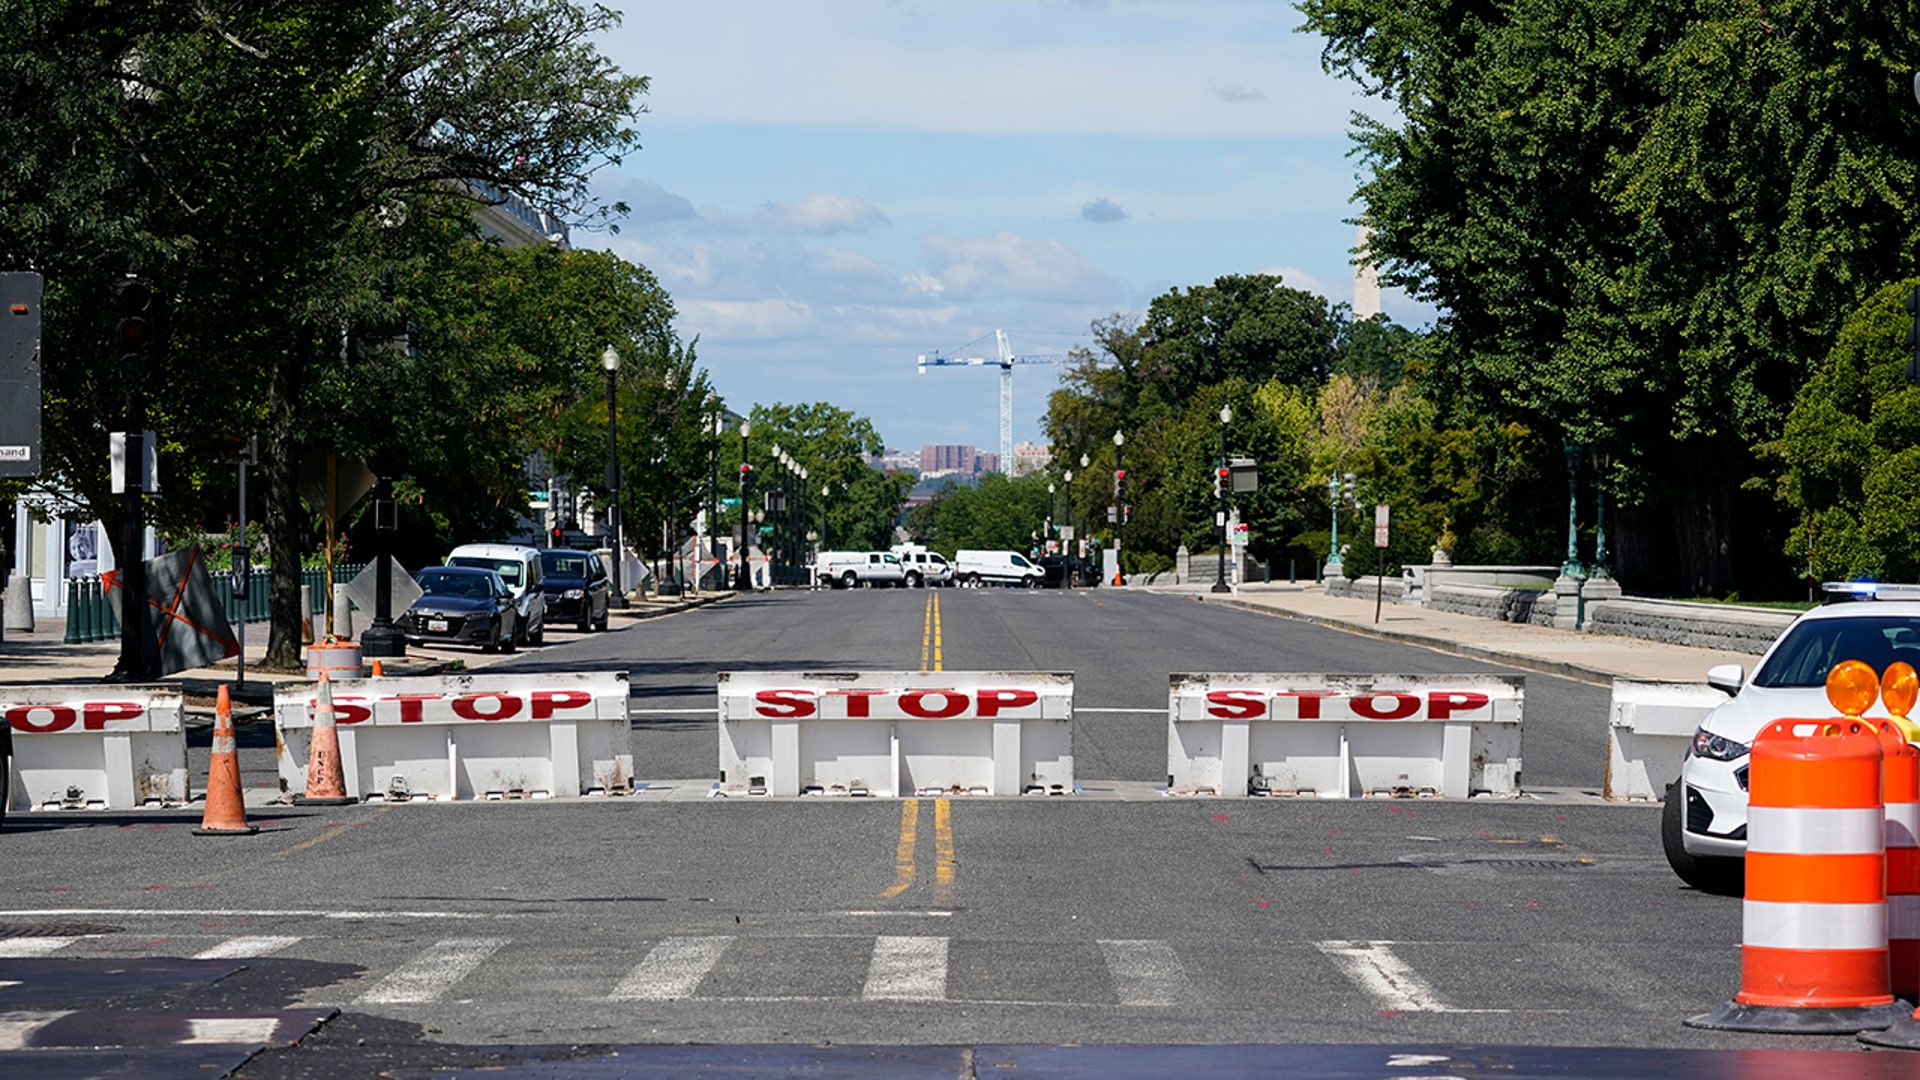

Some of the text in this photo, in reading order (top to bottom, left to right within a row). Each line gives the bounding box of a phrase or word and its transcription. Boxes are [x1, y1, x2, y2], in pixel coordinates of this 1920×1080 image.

[5, 702, 144, 732] OP
[309, 690, 592, 724] STOP
[756, 689, 1038, 718] STOP
[1206, 690, 1489, 720] STOP
